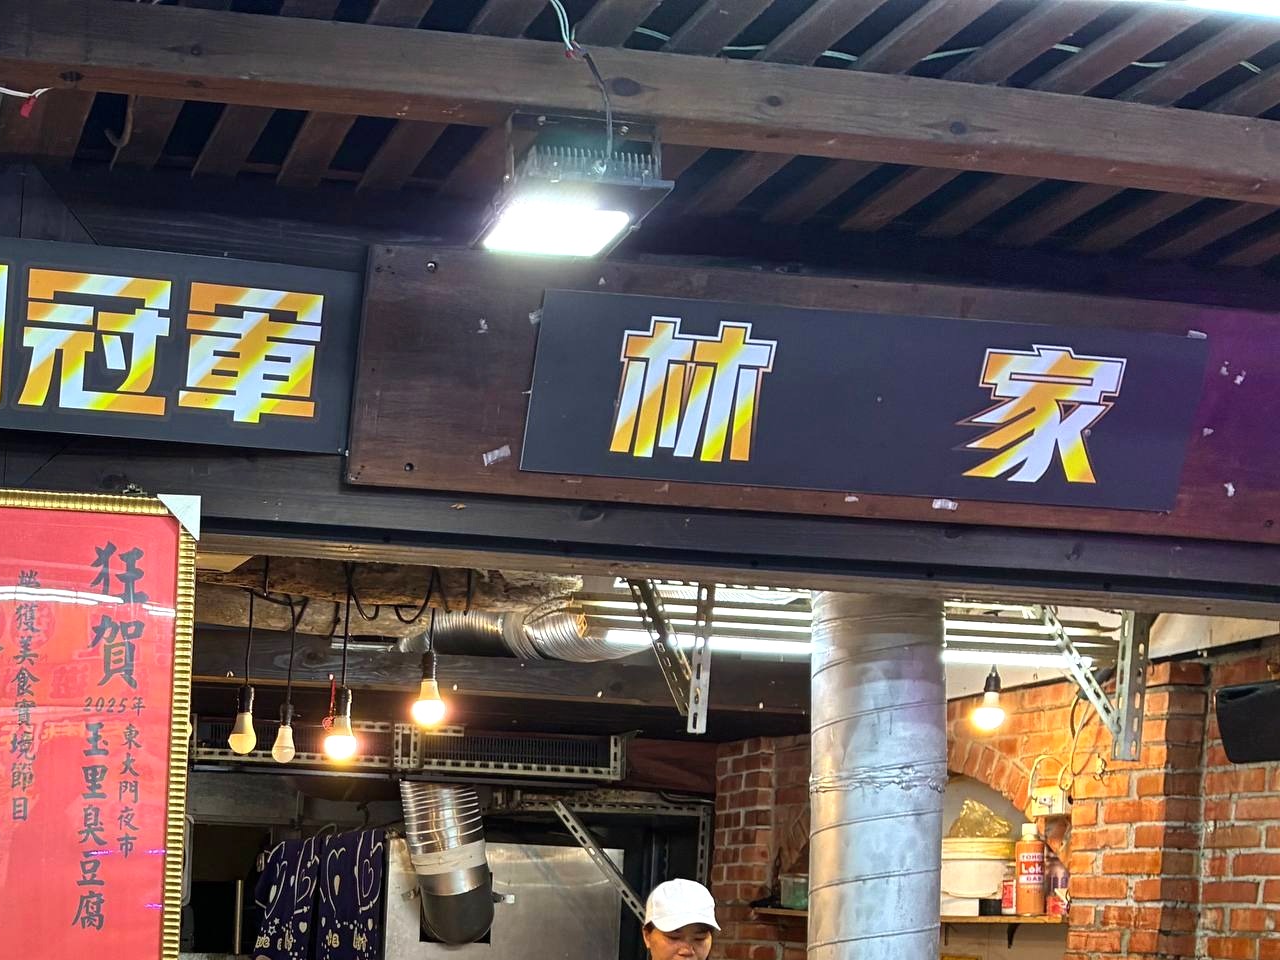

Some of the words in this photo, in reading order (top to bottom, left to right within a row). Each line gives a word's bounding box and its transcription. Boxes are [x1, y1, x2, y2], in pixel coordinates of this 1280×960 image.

[609, 315, 777, 462] 林
[958, 344, 1126, 484] 家
[88, 540, 148, 690] 狂賀
[82, 697, 146, 716] 2025年
[71, 723, 109, 931] 玉里臭豆腐
[116, 724, 142, 860] 東大門夜市
